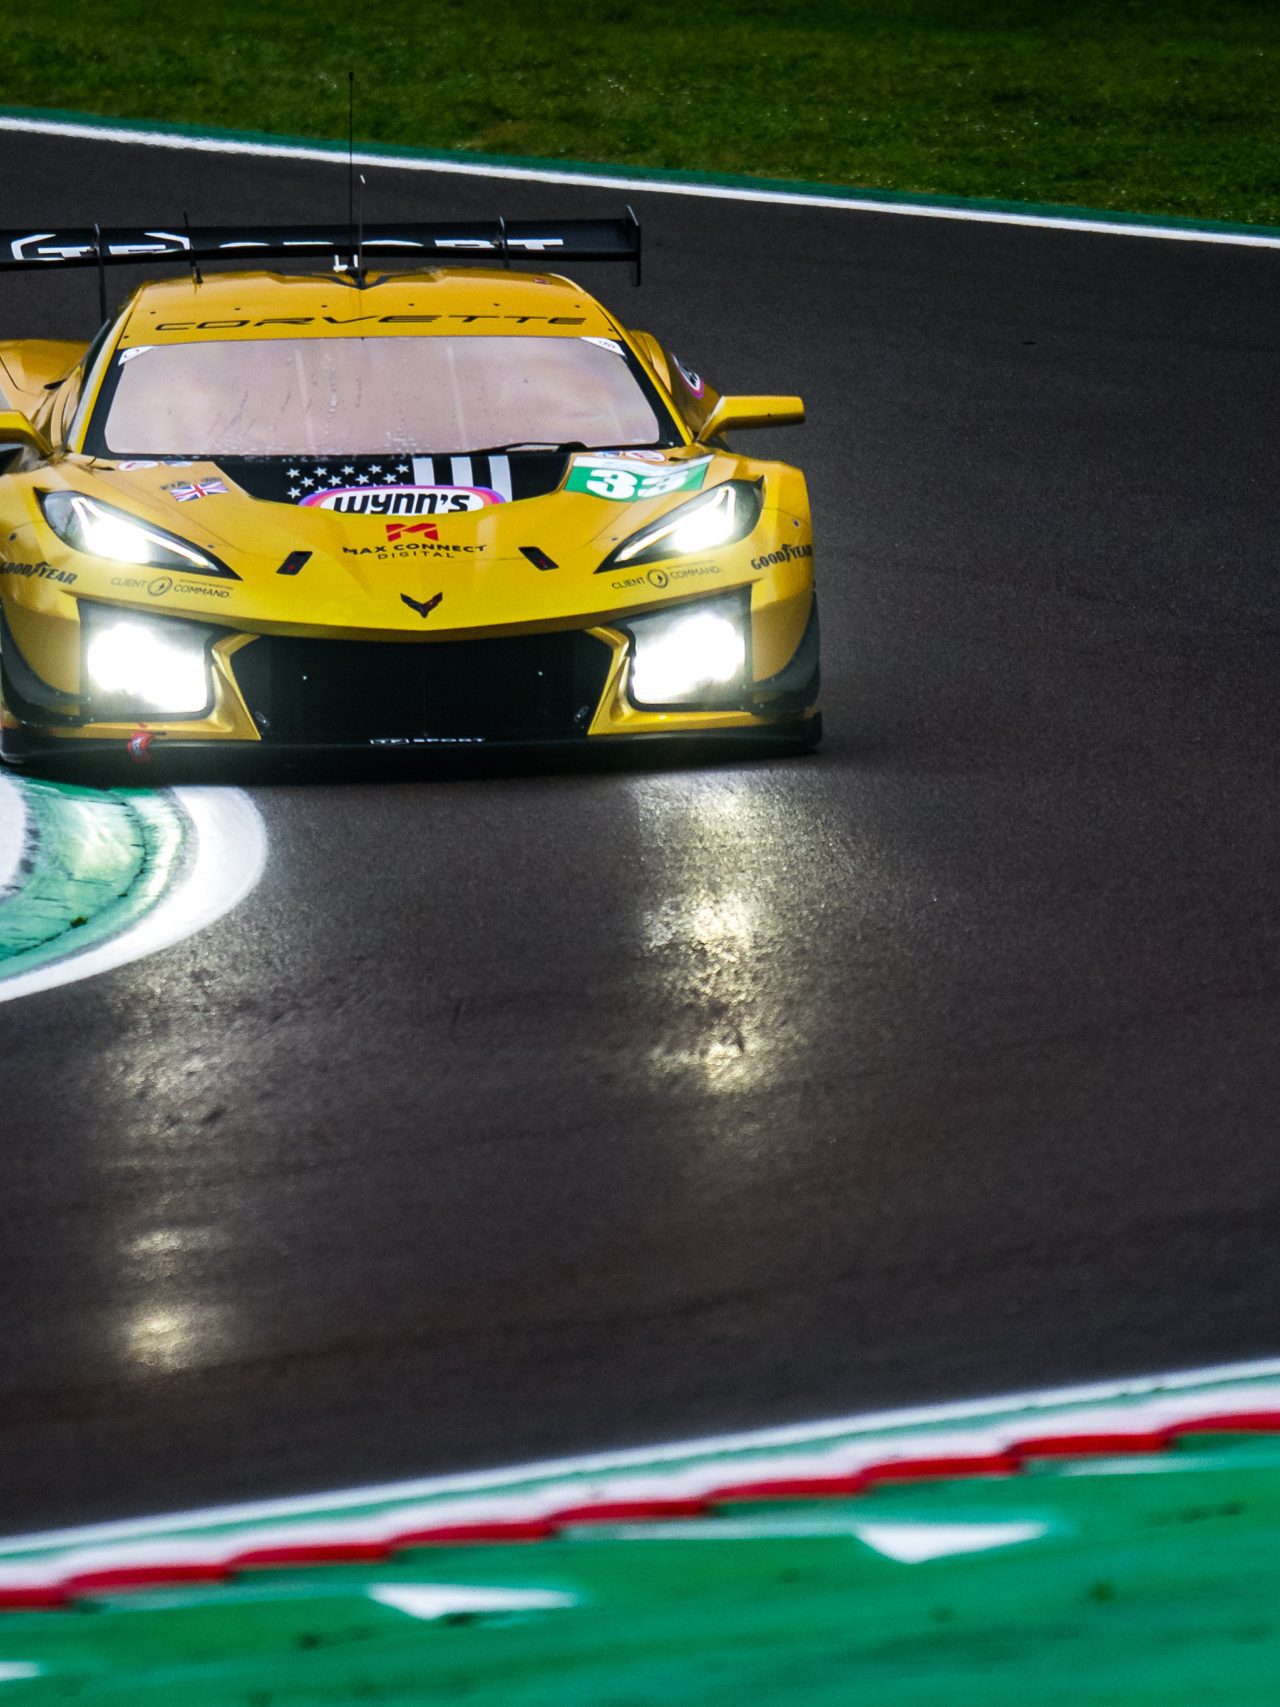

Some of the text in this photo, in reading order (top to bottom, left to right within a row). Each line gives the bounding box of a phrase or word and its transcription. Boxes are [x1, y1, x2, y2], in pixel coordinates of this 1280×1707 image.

[155, 314, 588, 331] CORVETTE
[586, 469, 688, 499] 33
[342, 543, 487, 555] MAX CONNECT
[377, 551, 456, 560] DIGITAL
[0, 561, 78, 585] GOODYEAR
[110, 577, 149, 589] CLIENT
[173, 584, 230, 598] COMMAND
[611, 576, 646, 590] CLIENT
